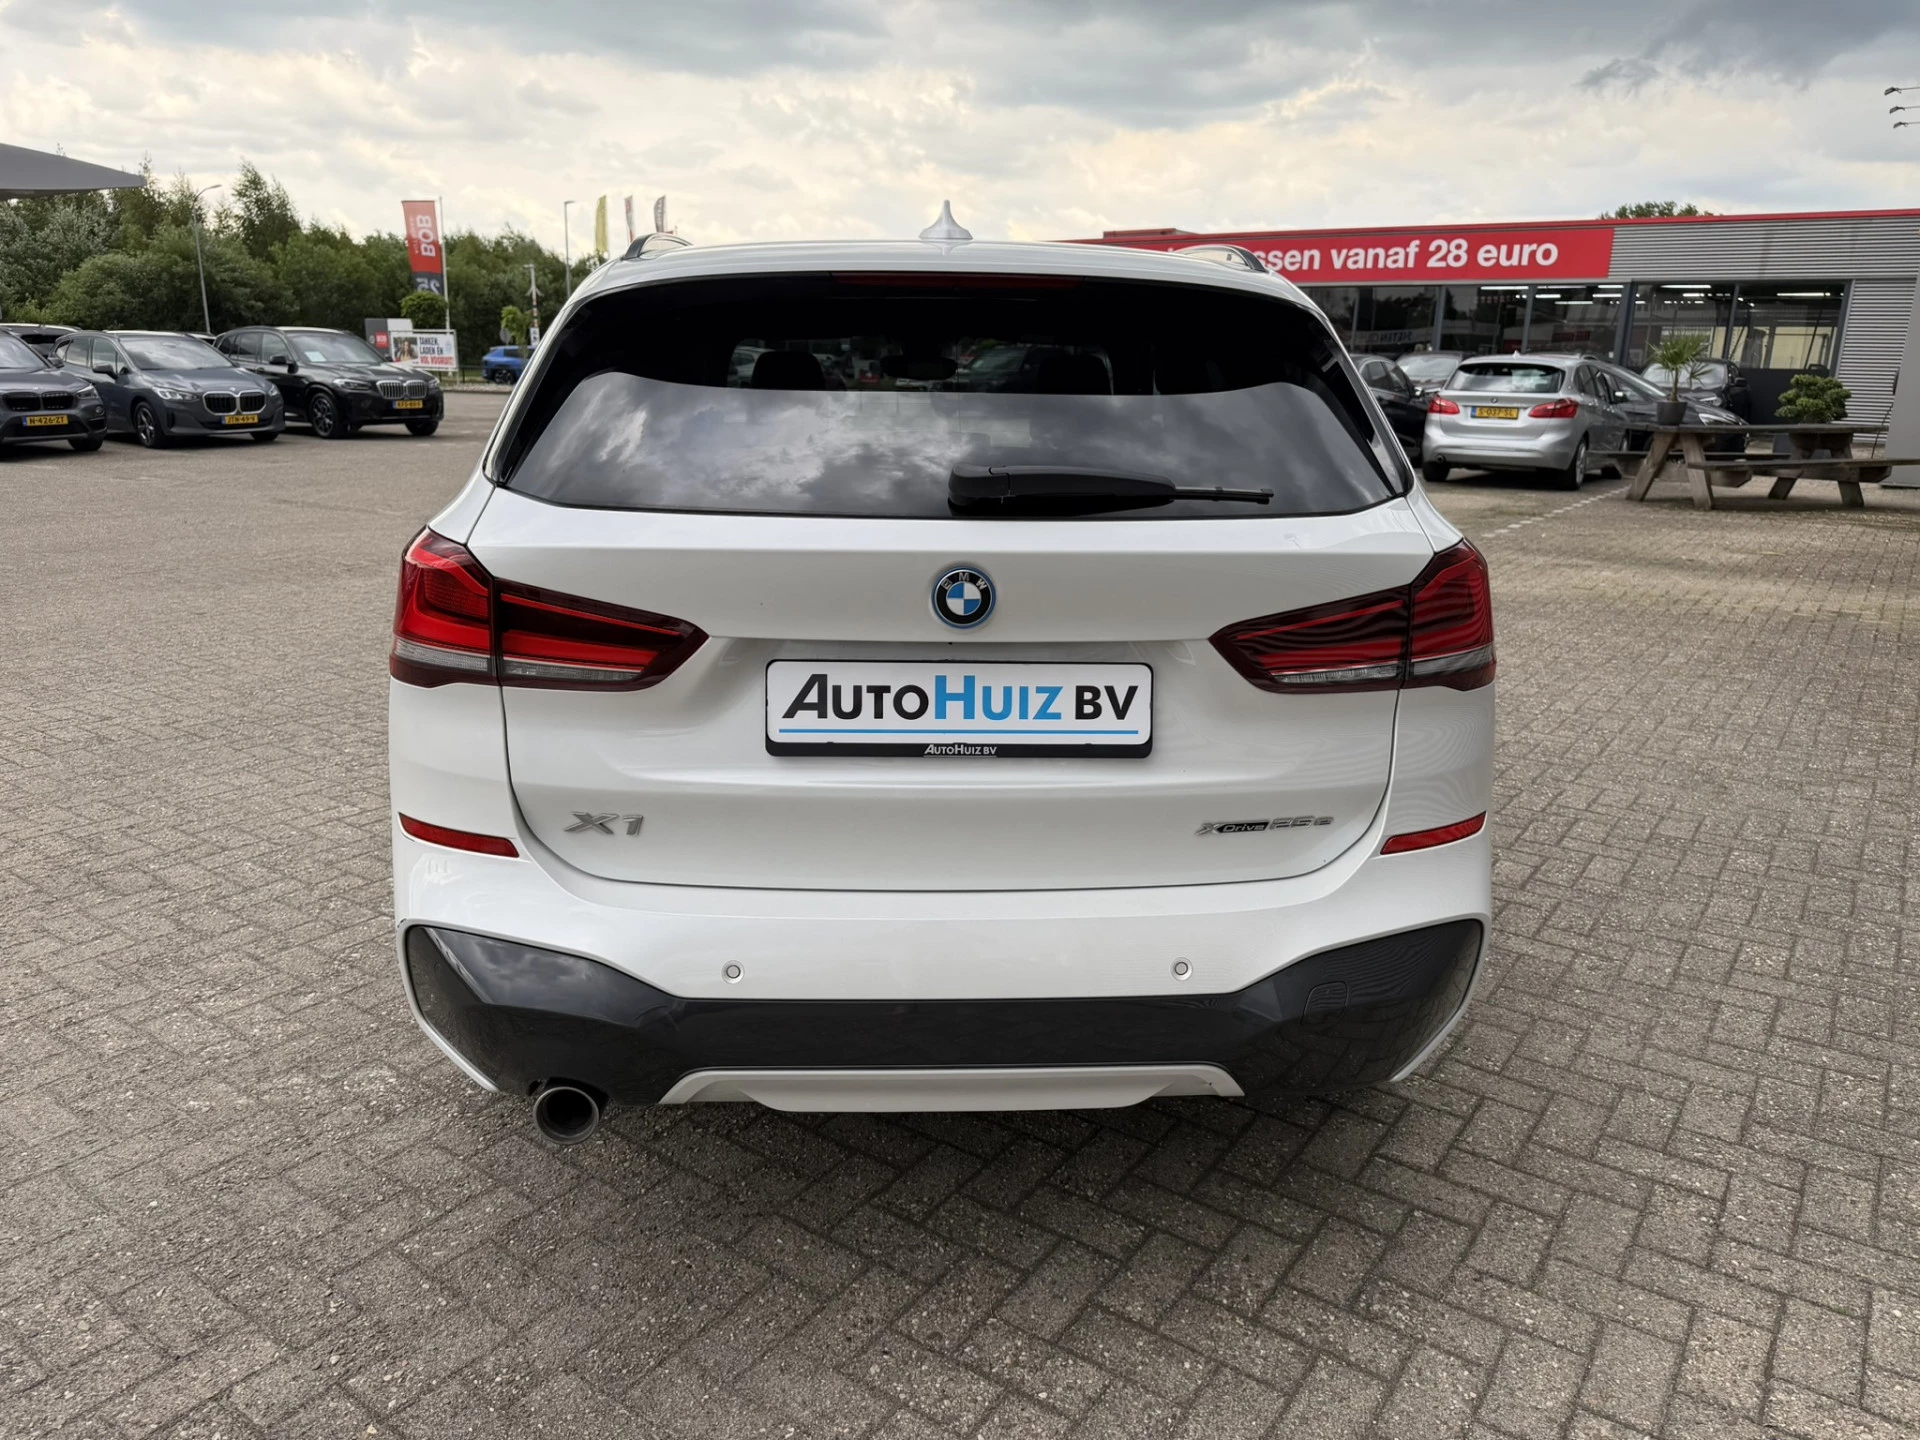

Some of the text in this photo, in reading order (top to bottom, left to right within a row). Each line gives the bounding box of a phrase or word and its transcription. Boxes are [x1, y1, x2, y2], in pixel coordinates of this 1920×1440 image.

[1330, 239, 1421, 270] vanaf
[1426, 238, 1468, 268] 28
[1477, 243, 1559, 267] euro
[940, 572, 988, 590] BMW
[1074, 685, 1139, 721] BV
[983, 746, 997, 755] BV
[564, 811, 644, 836] X1
